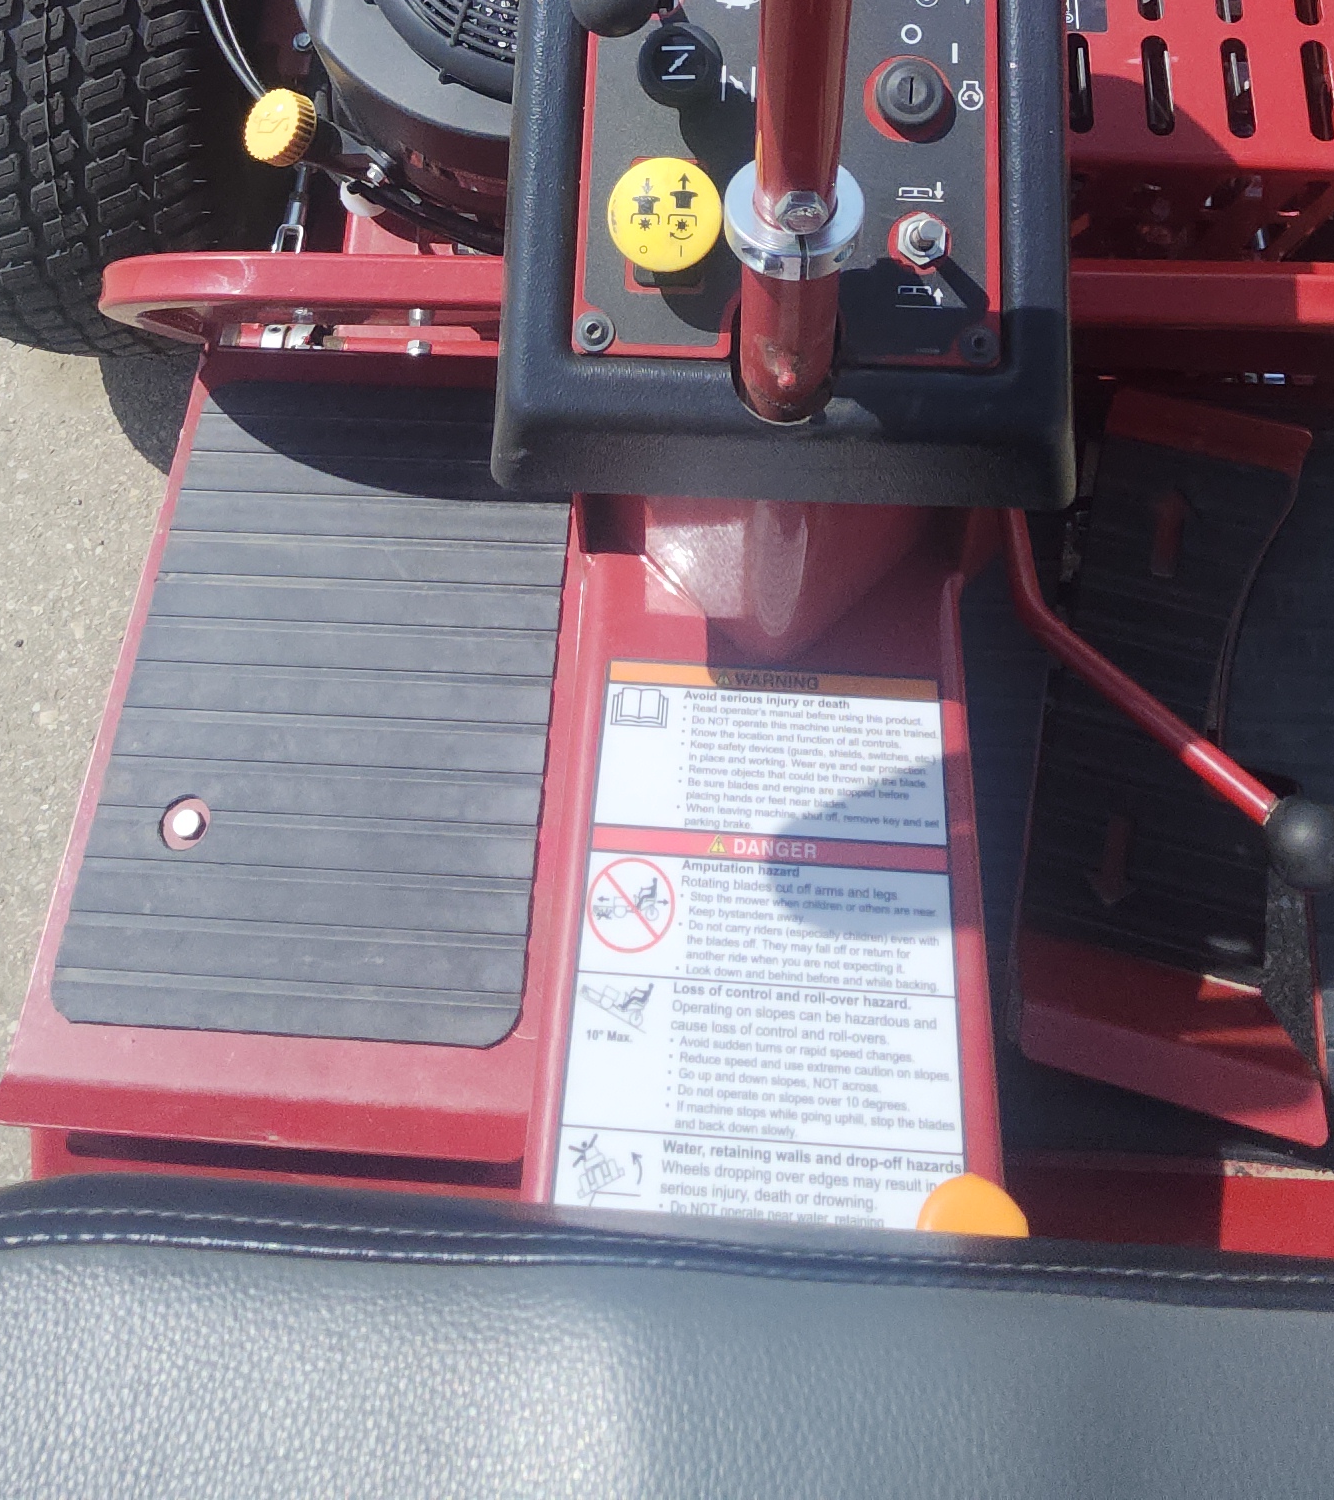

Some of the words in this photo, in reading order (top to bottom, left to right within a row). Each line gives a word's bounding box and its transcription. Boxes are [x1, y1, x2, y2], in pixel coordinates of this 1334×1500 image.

[733, 672, 819, 690] WARNING
[733, 838, 817, 859] DANGER
[757, 863, 800, 878] hazard
[680, 874, 730, 892] Rotating
[732, 877, 773, 892] blades
[773, 880, 795, 894] cut
[795, 881, 812, 895] off
[813, 885, 845, 897] arms
[845, 885, 871, 899] and
[687, 904, 716, 920] Keep
[684, 947, 726, 962] another
[727, 950, 748, 963] ride
[749, 951, 779, 965] when
[780, 956, 801, 969] you
[802, 958, 821, 968] are
[822, 956, 841, 970] not
[684, 962, 712, 976] Look
[713, 964, 743, 978] down
[744, 966, 766, 980] and
[766, 968, 804, 982] behind
[805, 970, 840, 985] before
[841, 973, 863, 986] and
[864, 974, 893, 988] while
[672, 980, 706, 996] Loss
[707, 983, 723, 997] of
[724, 984, 773, 1000] control
[775, 987, 801, 1002] and
[803, 989, 860, 1006] roll-over
[671, 998, 733, 1019] Operating
[734, 1005, 752, 1017] on
[754, 1004, 796, 1023] slopes
[798, 1010, 822, 1022] can
[824, 1008, 842, 1023] be
[843, 1010, 910, 1028] hazardous
[912, 1014, 938, 1030] and
[585, 1027, 604, 1041] 10°
[669, 1019, 708, 1033] cause
[710, 1019, 737, 1035] loss
[739, 1021, 753, 1036] of
[754, 1022, 798, 1039] control
[800, 1025, 826, 1041] and
[678, 1034, 710, 1048] Avoid
[711, 1036, 753, 1051] sudden
[754, 1039, 783, 1054] turns
[784, 1044, 797, 1055] or
[798, 1042, 827, 1060] rapid
[828, 1044, 864, 1062] speed
[678, 1050, 722, 1065] Reduce
[723, 1053, 758, 1071] speed
[759, 1056, 782, 1070] and
[783, 1060, 805, 1071] use
[805, 1059, 852, 1075] extreme
[853, 1062, 895, 1078] caution
[895, 1068, 912, 1079] on
[677, 1066, 696, 1080] Go
[697, 1070, 712, 1084] up
[713, 1069, 736, 1083] and
[737, 1070, 769, 1085] down
[811, 1076, 838, 1090] NOT
[676, 1082, 694, 1096] Do
[695, 1083, 714, 1098] not
[715, 1085, 759, 1104] operate
[760, 1091, 776, 1102] on
[777, 1089, 815, 1108] slopes
[816, 1095, 842, 1107] over
[845, 1094, 860, 1108] 10
[673, 1115, 696, 1130] and
[697, 1117, 726, 1132] back
[726, 1119, 759, 1134] down
[675, 1098, 684, 1112] If
[685, 1099, 734, 1116] machine
[735, 1103, 767, 1121] stops
[768, 1105, 799, 1120] while
[799, 1107, 832, 1126] going
[869, 1112, 895, 1130] stop
[896, 1114, 916, 1129] the
[917, 1116, 956, 1132] blades
[708, 1141, 772, 1164] retaining
[774, 1146, 812, 1163] walls
[814, 1149, 842, 1166] and
[845, 1151, 902, 1173] drop-off
[661, 1158, 711, 1177] Wheels
[713, 1162, 772, 1185] dropping
[774, 1170, 805, 1184] over
[807, 1169, 850, 1190] edges
[851, 1175, 882, 1193] may
[884, 1174, 922, 1192] result
[659, 1178, 708, 1197] serious
[752, 1185, 792, 1203] death
[794, 1192, 810, 1205] or
